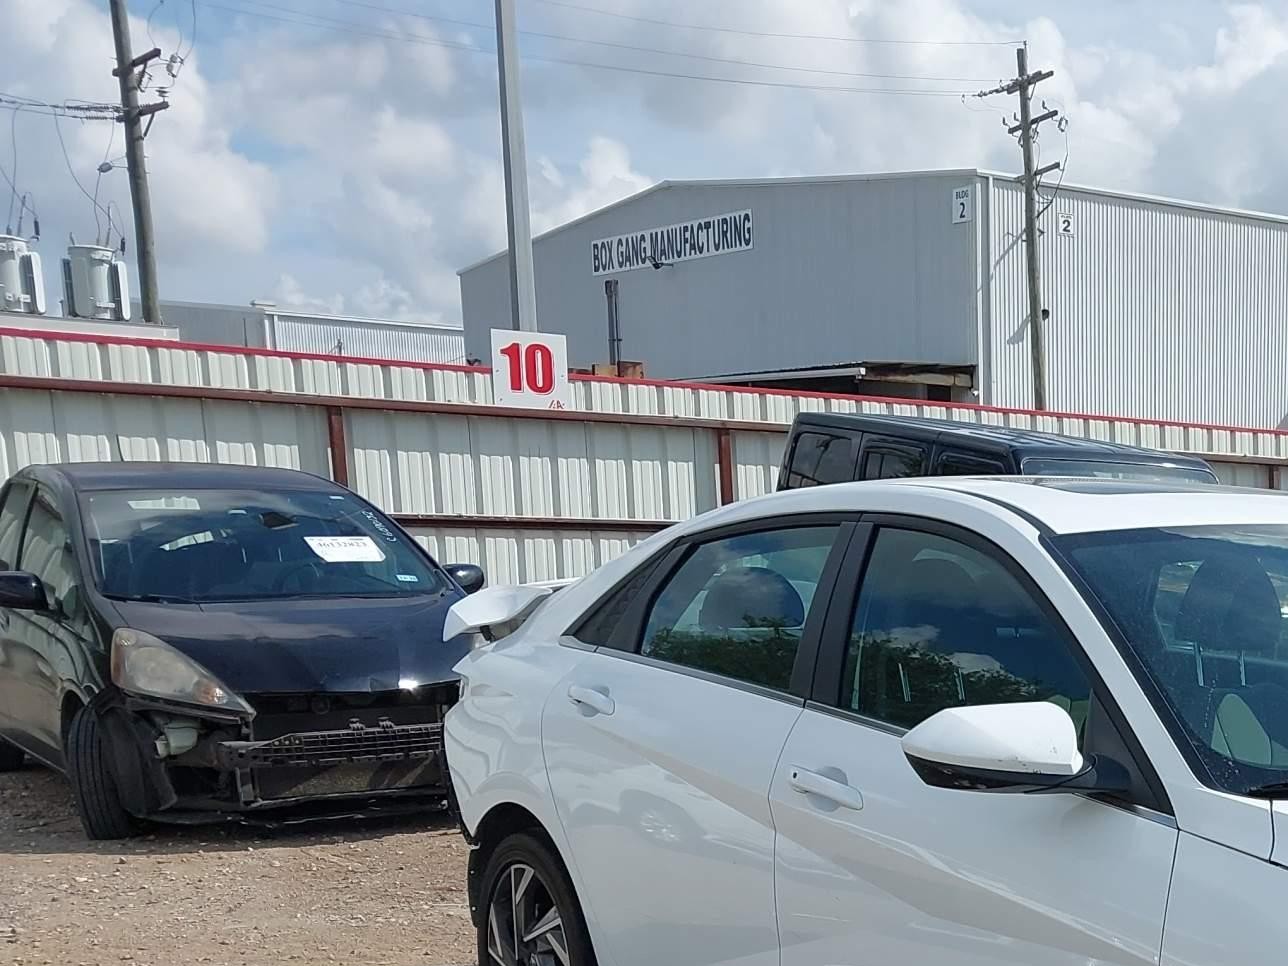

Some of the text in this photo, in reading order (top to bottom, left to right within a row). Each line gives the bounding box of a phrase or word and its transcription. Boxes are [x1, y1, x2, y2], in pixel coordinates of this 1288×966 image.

[955, 189, 969, 200] BLDG
[959, 202, 966, 219] 2
[1062, 219, 1071, 233] 2
[593, 212, 752, 273] BOX GANG MANUFACTURING
[499, 342, 555, 395] 10
